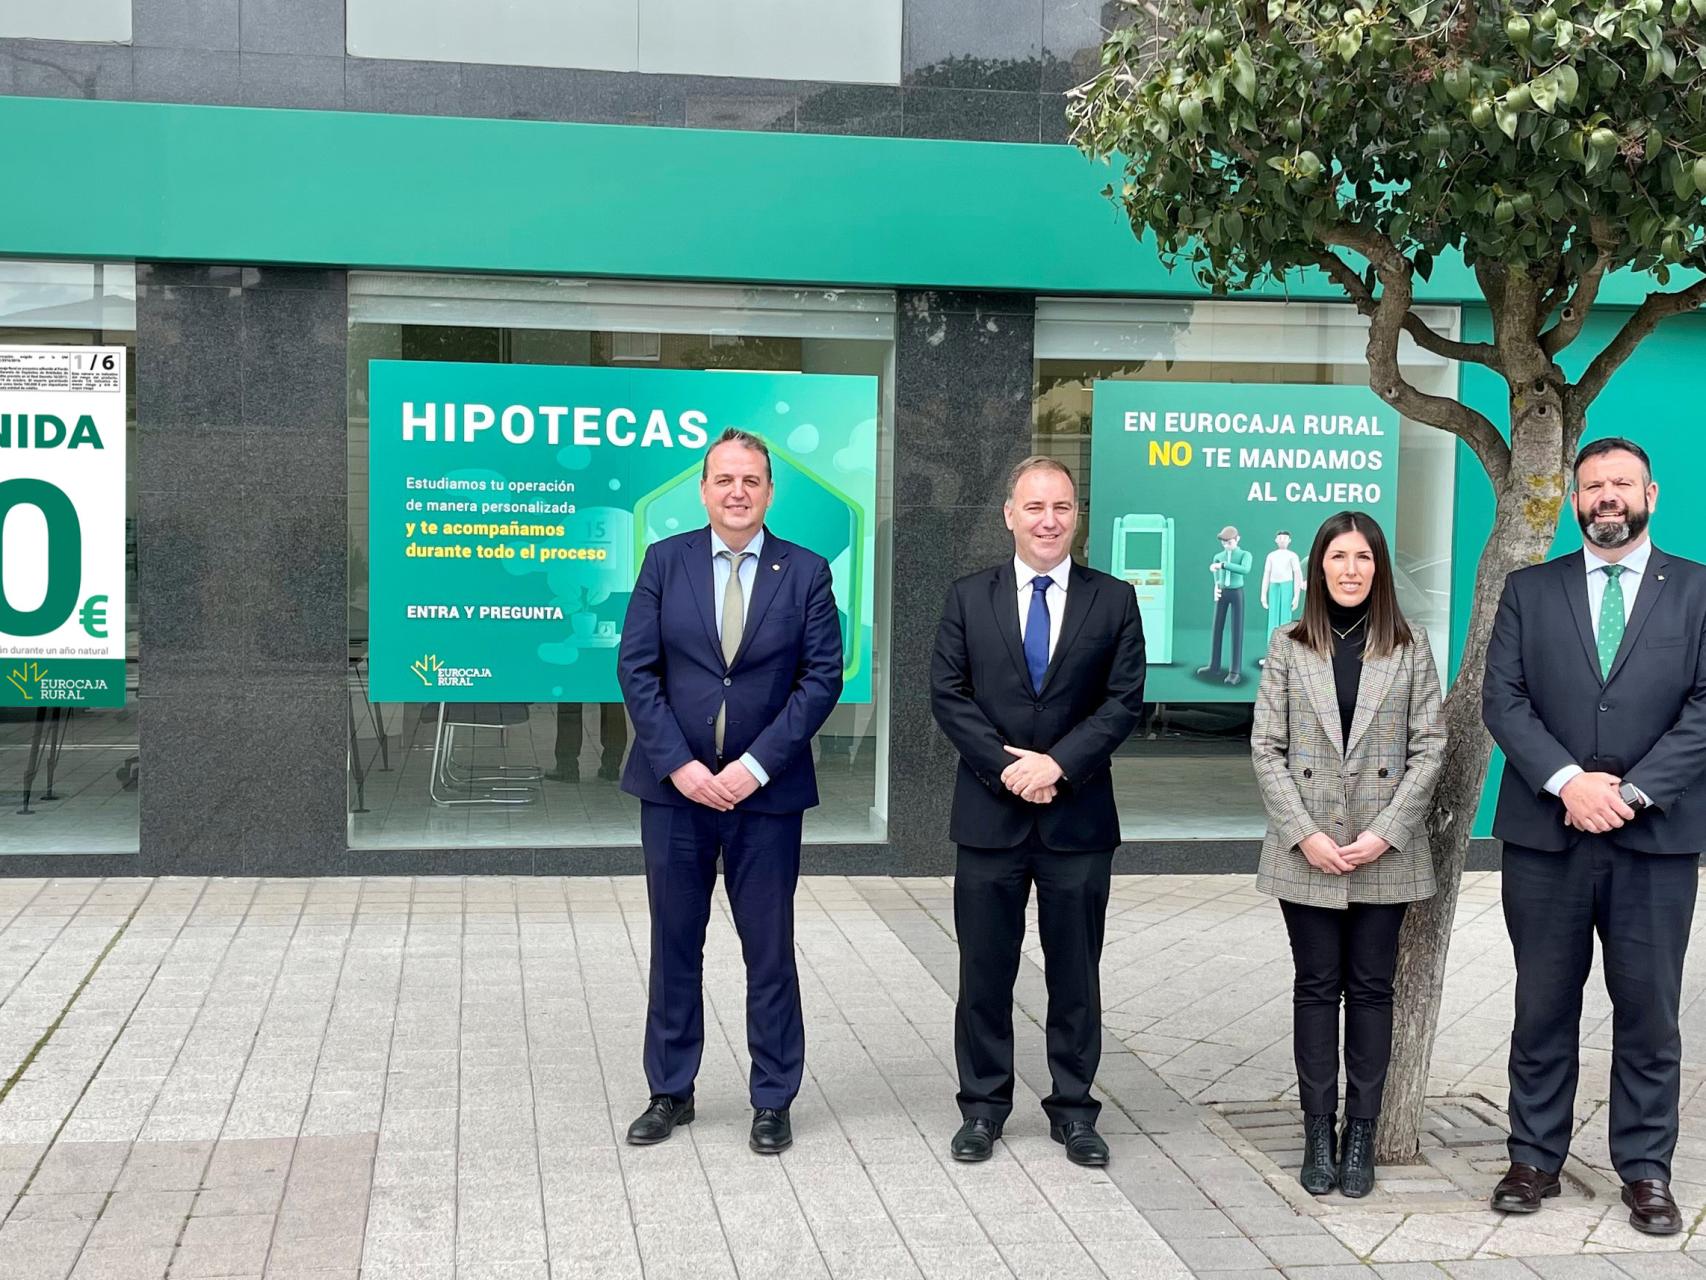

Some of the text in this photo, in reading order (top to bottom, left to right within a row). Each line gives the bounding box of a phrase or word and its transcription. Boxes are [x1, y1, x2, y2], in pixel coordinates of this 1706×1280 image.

[402, 402, 707, 448] HIPOTECAS
[1124, 411, 1384, 436] EN EUROCAJA RURAL
[1148, 440, 1383, 470] NO TE MANDAMOS
[406, 477, 575, 494] Estudiamos tu operación
[1247, 481, 1381, 504] AL CAJERO
[405, 499, 576, 515] de manera personalizada
[405, 521, 565, 538] y te acompañamos
[405, 542, 607, 562] durante todo el proceso
[407, 605, 564, 620] ENTRA Y PREGUNTA
[10, 646, 44, 654] durante
[59, 646, 76, 655] año
[78, 647, 109, 655] natural
[437, 668, 492, 678] EUROCAJA
[40, 679, 109, 690] EUROCAJA
[437, 677, 474, 686] RURAL
[40, 690, 85, 700] RURAL
